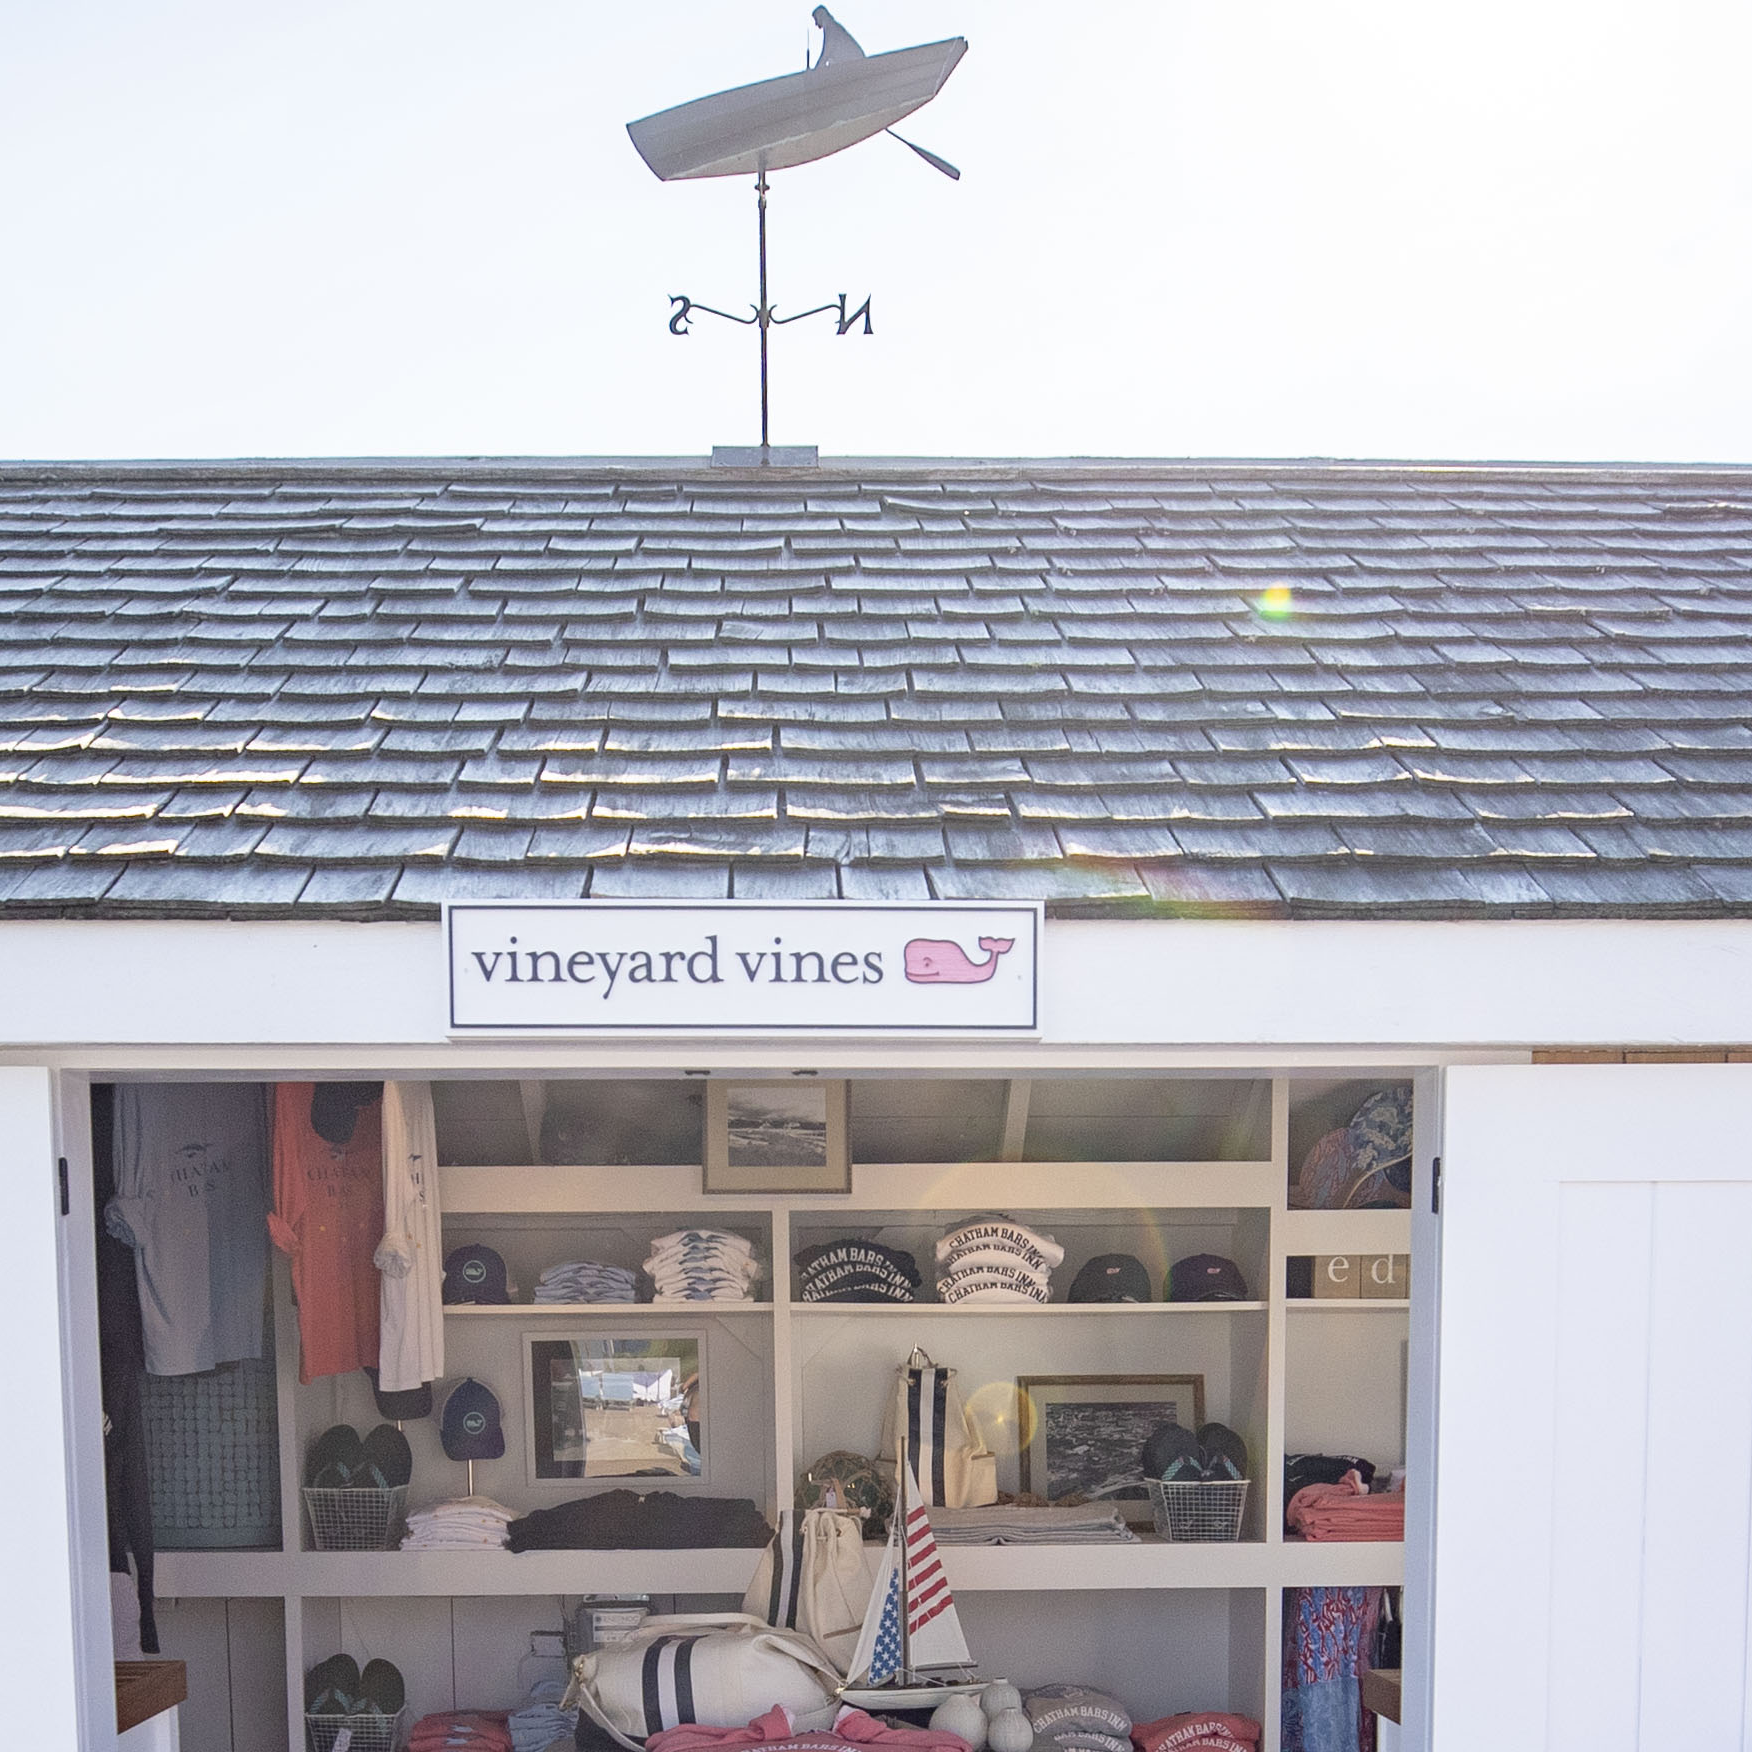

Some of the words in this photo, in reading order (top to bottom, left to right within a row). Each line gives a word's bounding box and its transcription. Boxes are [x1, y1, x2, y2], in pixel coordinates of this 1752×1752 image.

[471, 934, 725, 1000] vineyard
[736, 936, 884, 984] vines
[949, 1226, 999, 1249] CHATHAM
[1000, 1227, 1030, 1249] BARS
[849, 1247, 885, 1267] BARS
[948, 1243, 992, 1266] HATHAM
[1021, 1252, 1044, 1270] INN
[939, 1265, 985, 1296] CHATHAM
[986, 1265, 1016, 1279] BARS
[947, 1281, 999, 1304] CHATHAM
[1032, 1706, 1079, 1734] CHATHAM
[1079, 1705, 1108, 1720] BARS
[1107, 1712, 1128, 1732] INN
[800, 1743, 839, 1752] BARS
